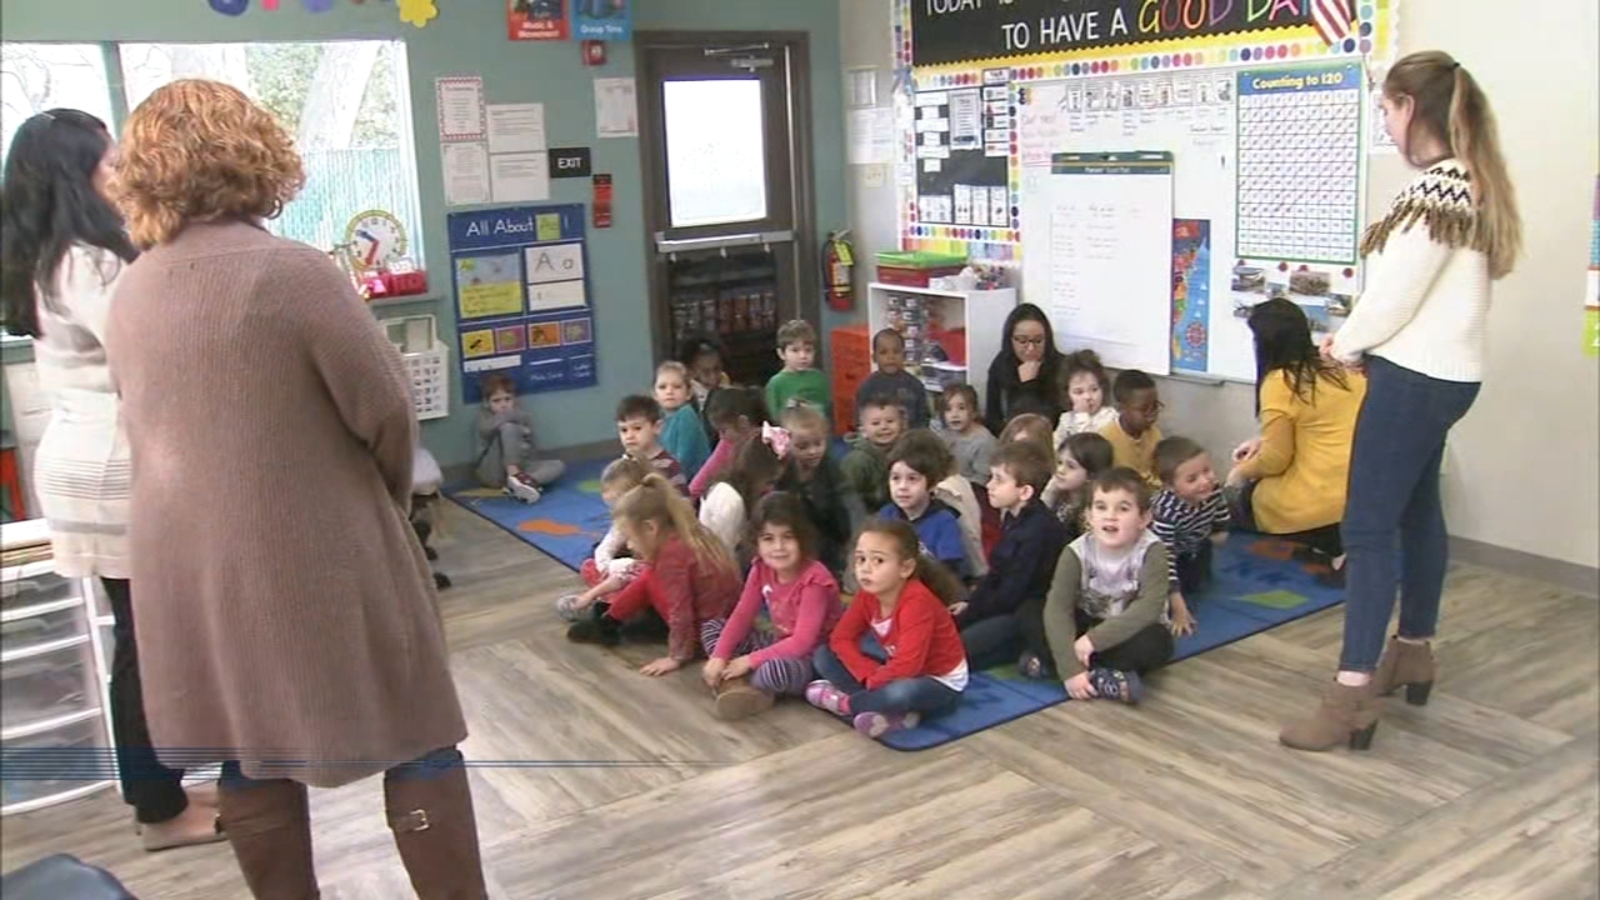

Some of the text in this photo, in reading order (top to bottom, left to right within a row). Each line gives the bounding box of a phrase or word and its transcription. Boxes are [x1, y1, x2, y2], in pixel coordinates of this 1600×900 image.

[523, 20, 545, 30] Music
[580, 24, 604, 35] Group
[1001, 22, 1030, 50] TO
[1040, 11, 1100, 45] HAVE
[1110, 7, 1129, 37] A
[1138, 0, 1232, 33] GOOD
[1252, 72, 1343, 90] Counting to 120
[557, 156, 582, 169] EXIT
[466, 220, 490, 237] All
[493, 216, 534, 234] About
